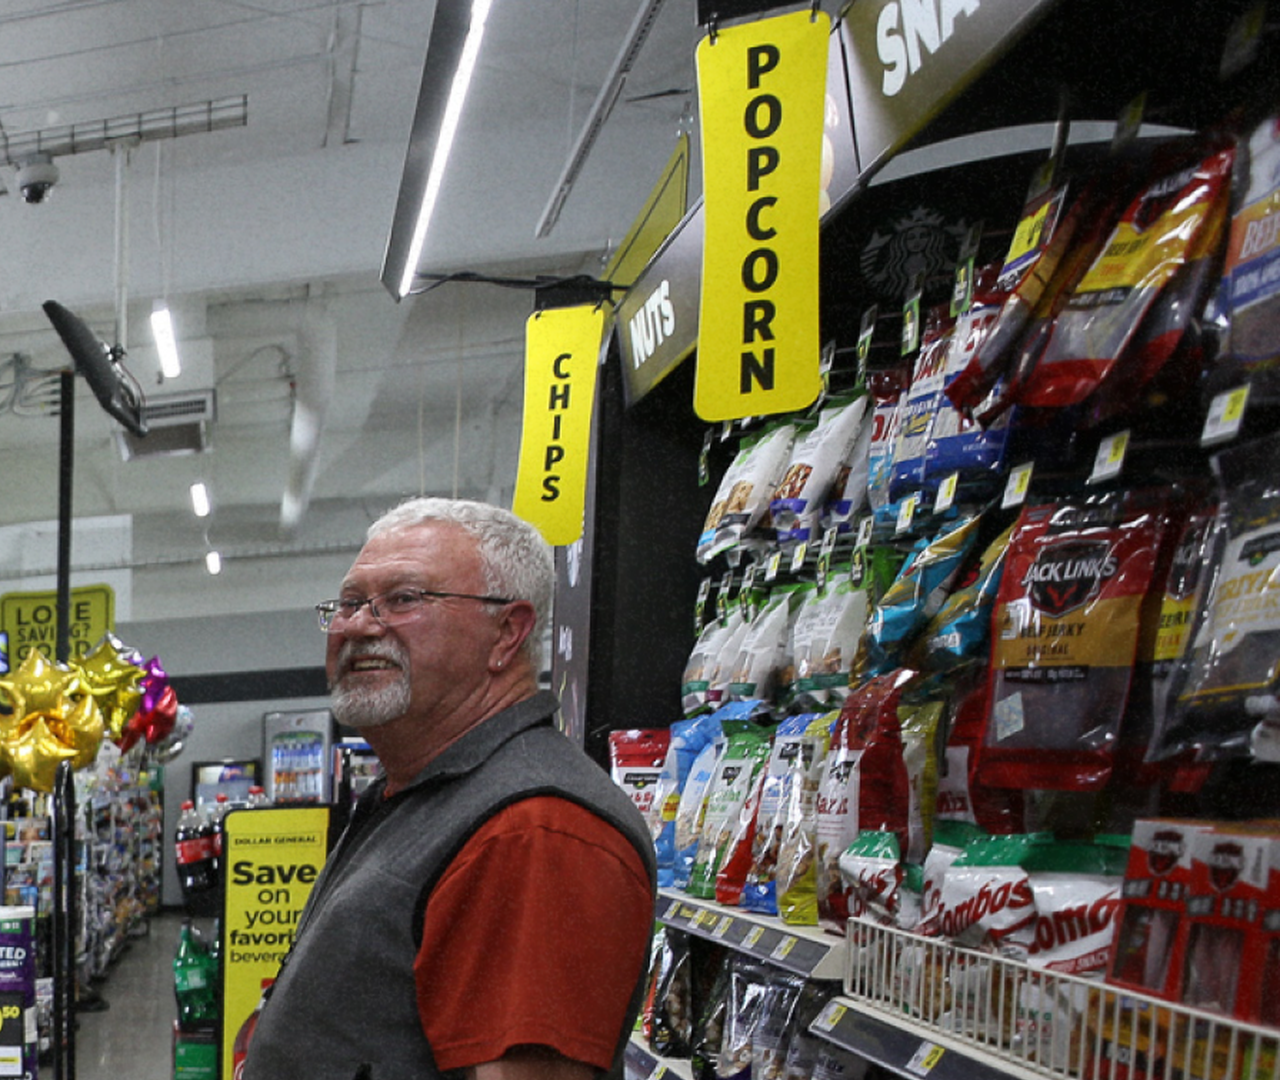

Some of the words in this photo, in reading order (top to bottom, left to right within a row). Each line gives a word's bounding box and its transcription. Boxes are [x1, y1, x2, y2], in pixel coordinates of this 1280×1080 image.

[740, 44, 782, 394] POPCORN
[629, 279, 676, 370] NUTS
[542, 354, 571, 502] CHIPS
[1022, 559, 1062, 587] JACK
[17, 602, 91, 626] LOE
[18, 622, 90, 643] SAVIG?
[233, 860, 317, 884] Save
[258, 888, 290, 904] on
[245, 907, 301, 929] your
